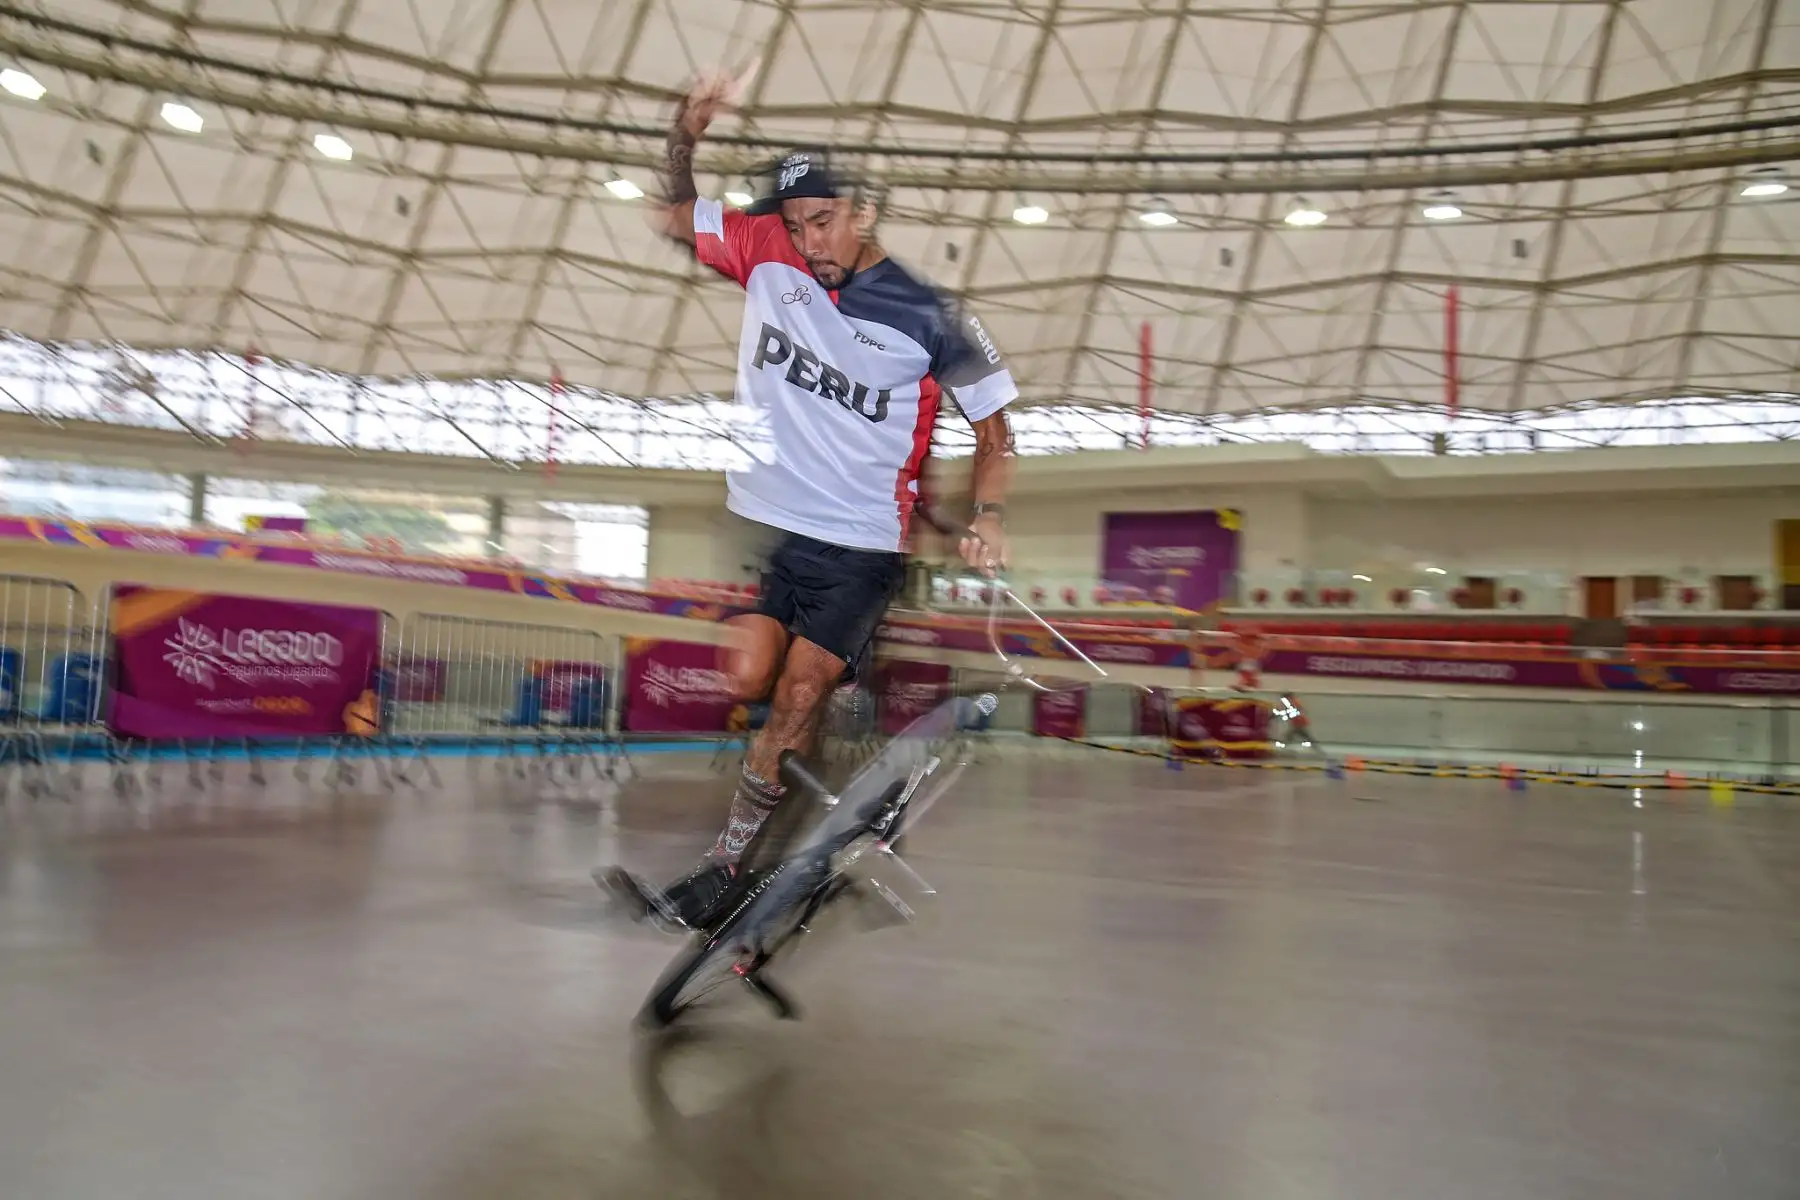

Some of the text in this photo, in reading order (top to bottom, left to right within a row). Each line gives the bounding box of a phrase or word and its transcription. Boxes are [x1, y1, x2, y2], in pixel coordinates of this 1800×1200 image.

[854, 330, 886, 351] FDPC
[969, 316, 1001, 365] PERU
[751, 321, 892, 424] PERU
